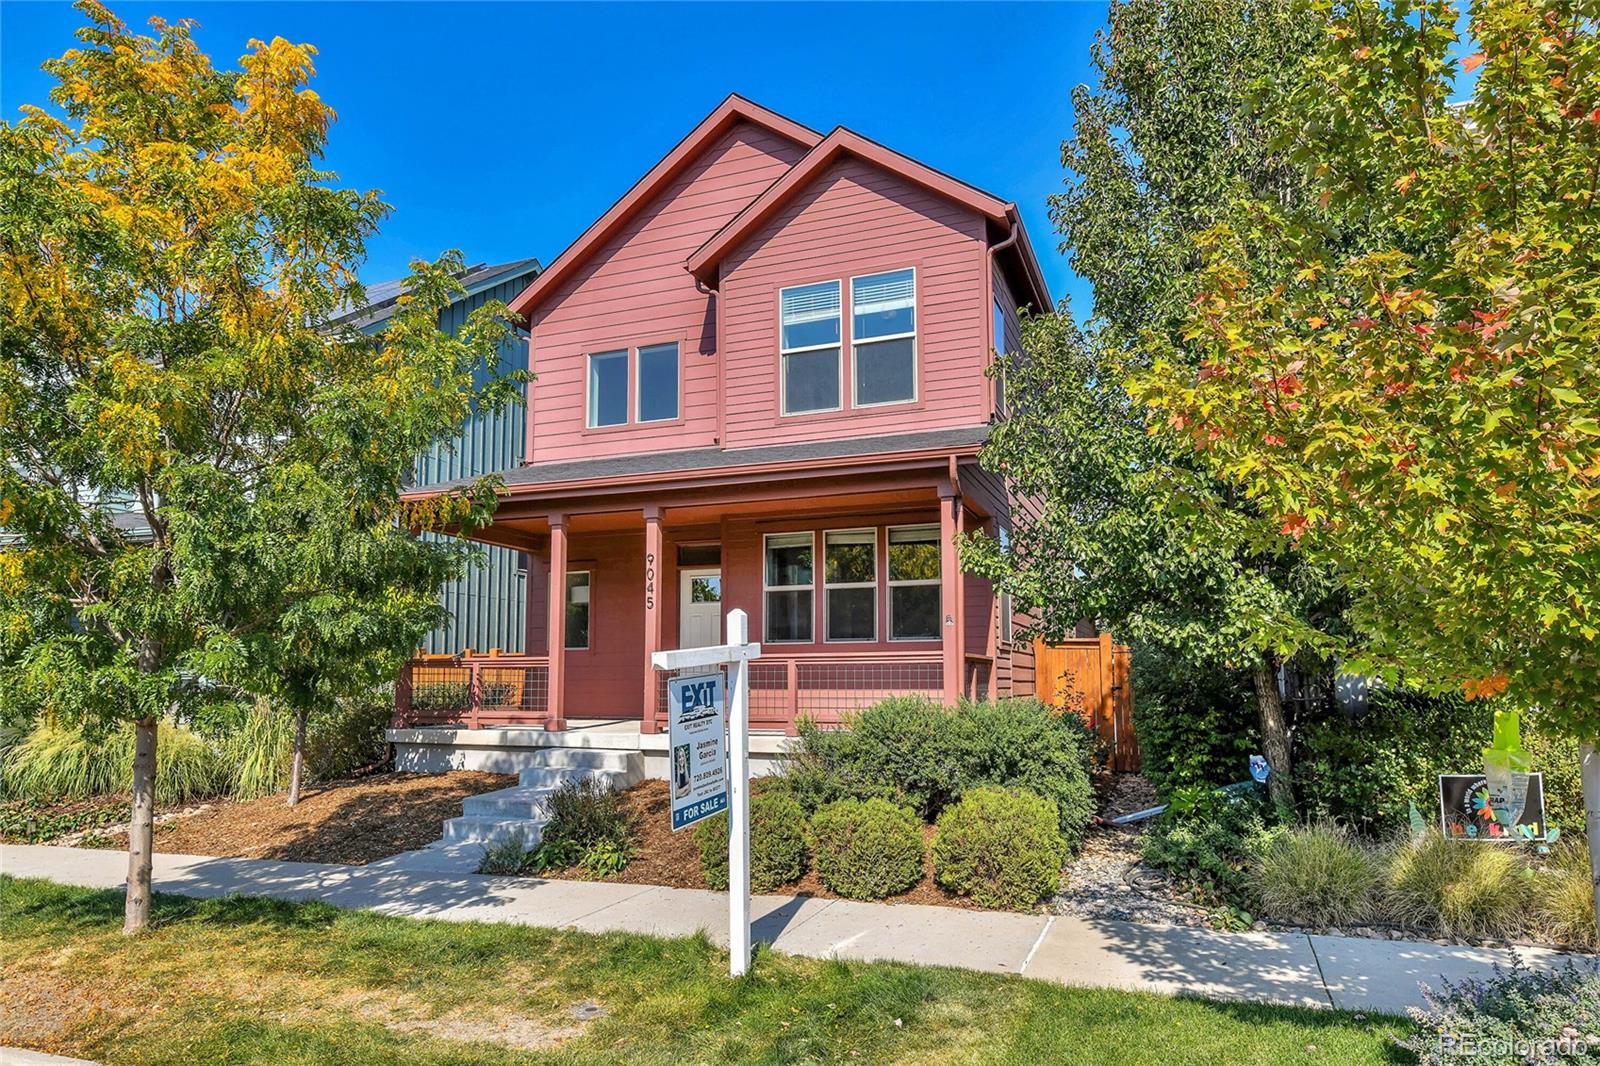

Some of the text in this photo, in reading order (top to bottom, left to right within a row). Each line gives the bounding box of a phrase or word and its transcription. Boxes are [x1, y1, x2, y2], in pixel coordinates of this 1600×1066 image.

[646, 553, 654, 610] 9045
[681, 681, 716, 713] EXIT
[697, 739, 718, 750] Jasmine
[699, 749, 716, 760] Garcia
[683, 806, 699, 821] FOR
[700, 798, 719, 814] SALE
